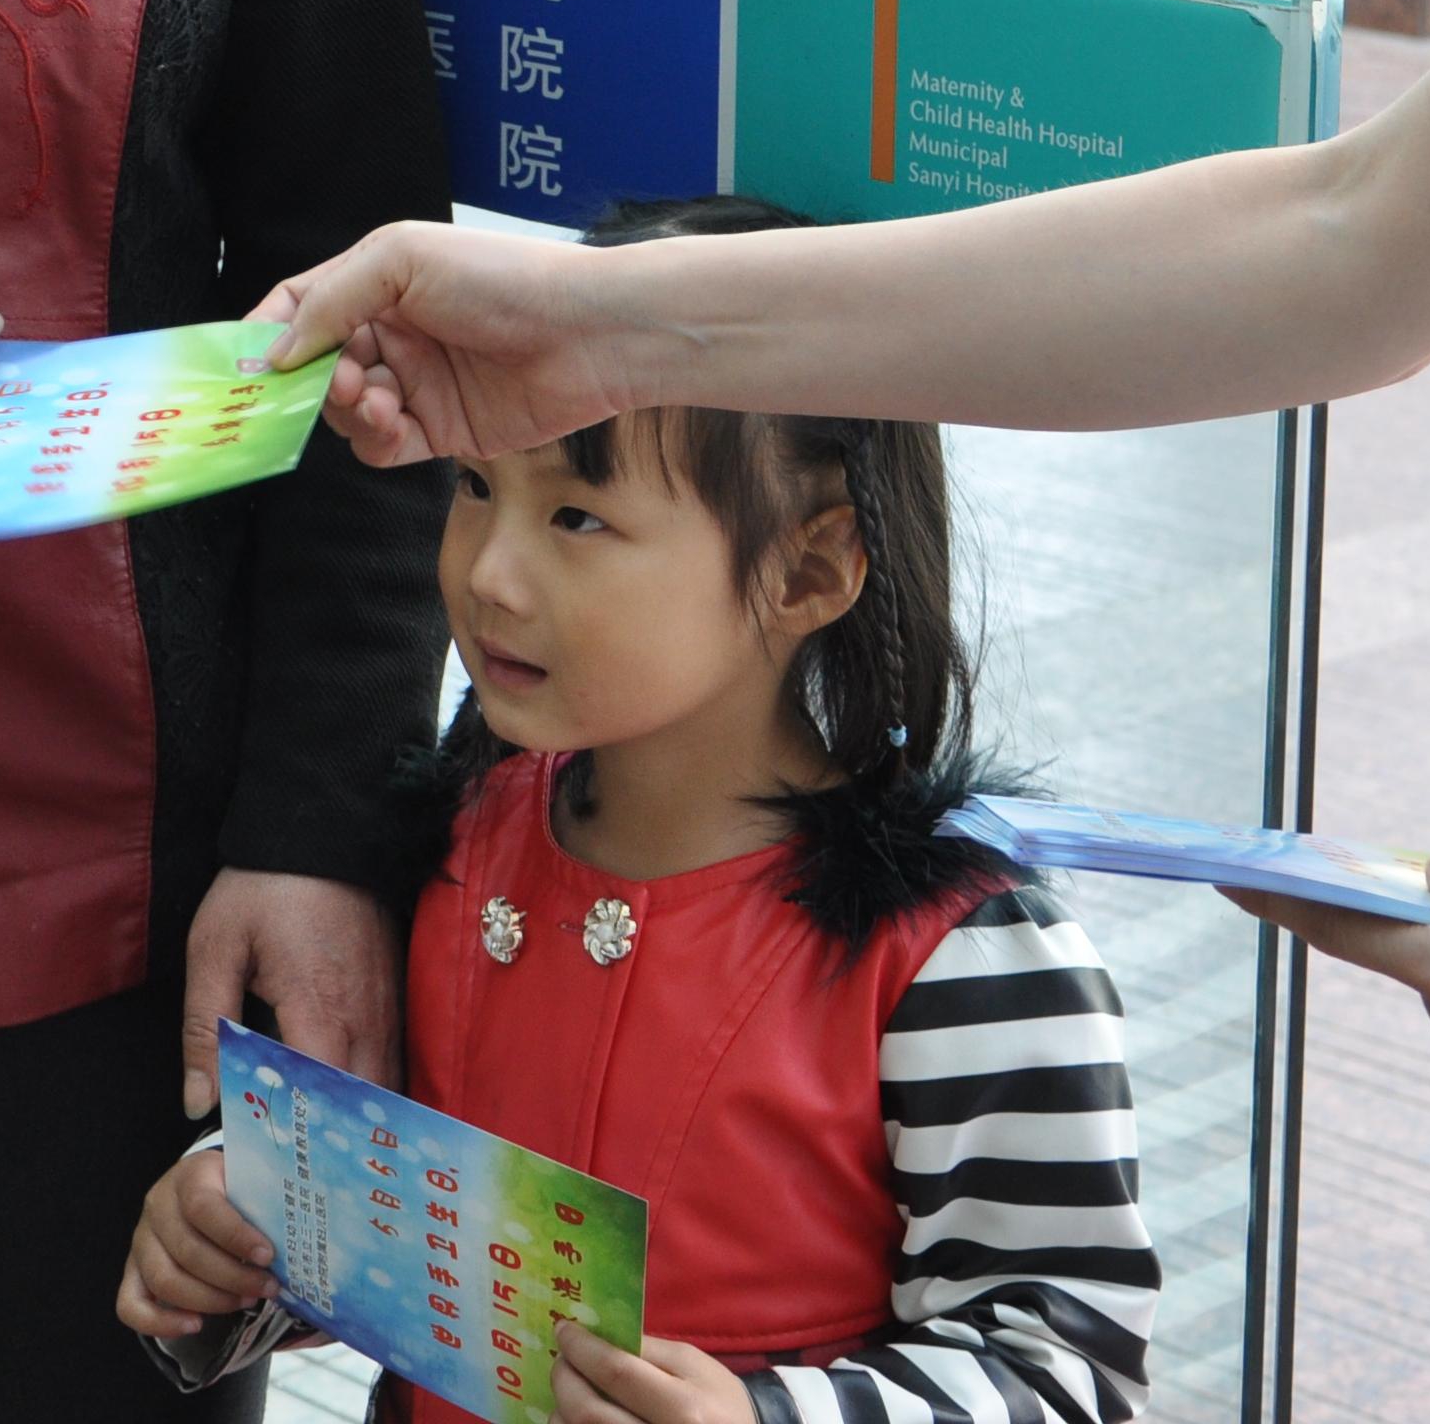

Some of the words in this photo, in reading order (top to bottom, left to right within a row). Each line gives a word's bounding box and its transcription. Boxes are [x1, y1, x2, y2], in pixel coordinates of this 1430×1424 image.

[910, 68, 1004, 110] Maternity
[1010, 86, 1025, 109] &
[909, 131, 1007, 170] Municipal
[910, 100, 962, 129] Child
[968, 109, 1033, 142] Health
[1038, 123, 1123, 159] Hospital
[499, 122, 563, 197] 院
[908, 162, 960, 195] Sanyi
[366, 1126, 402, 1238] 5月5日
